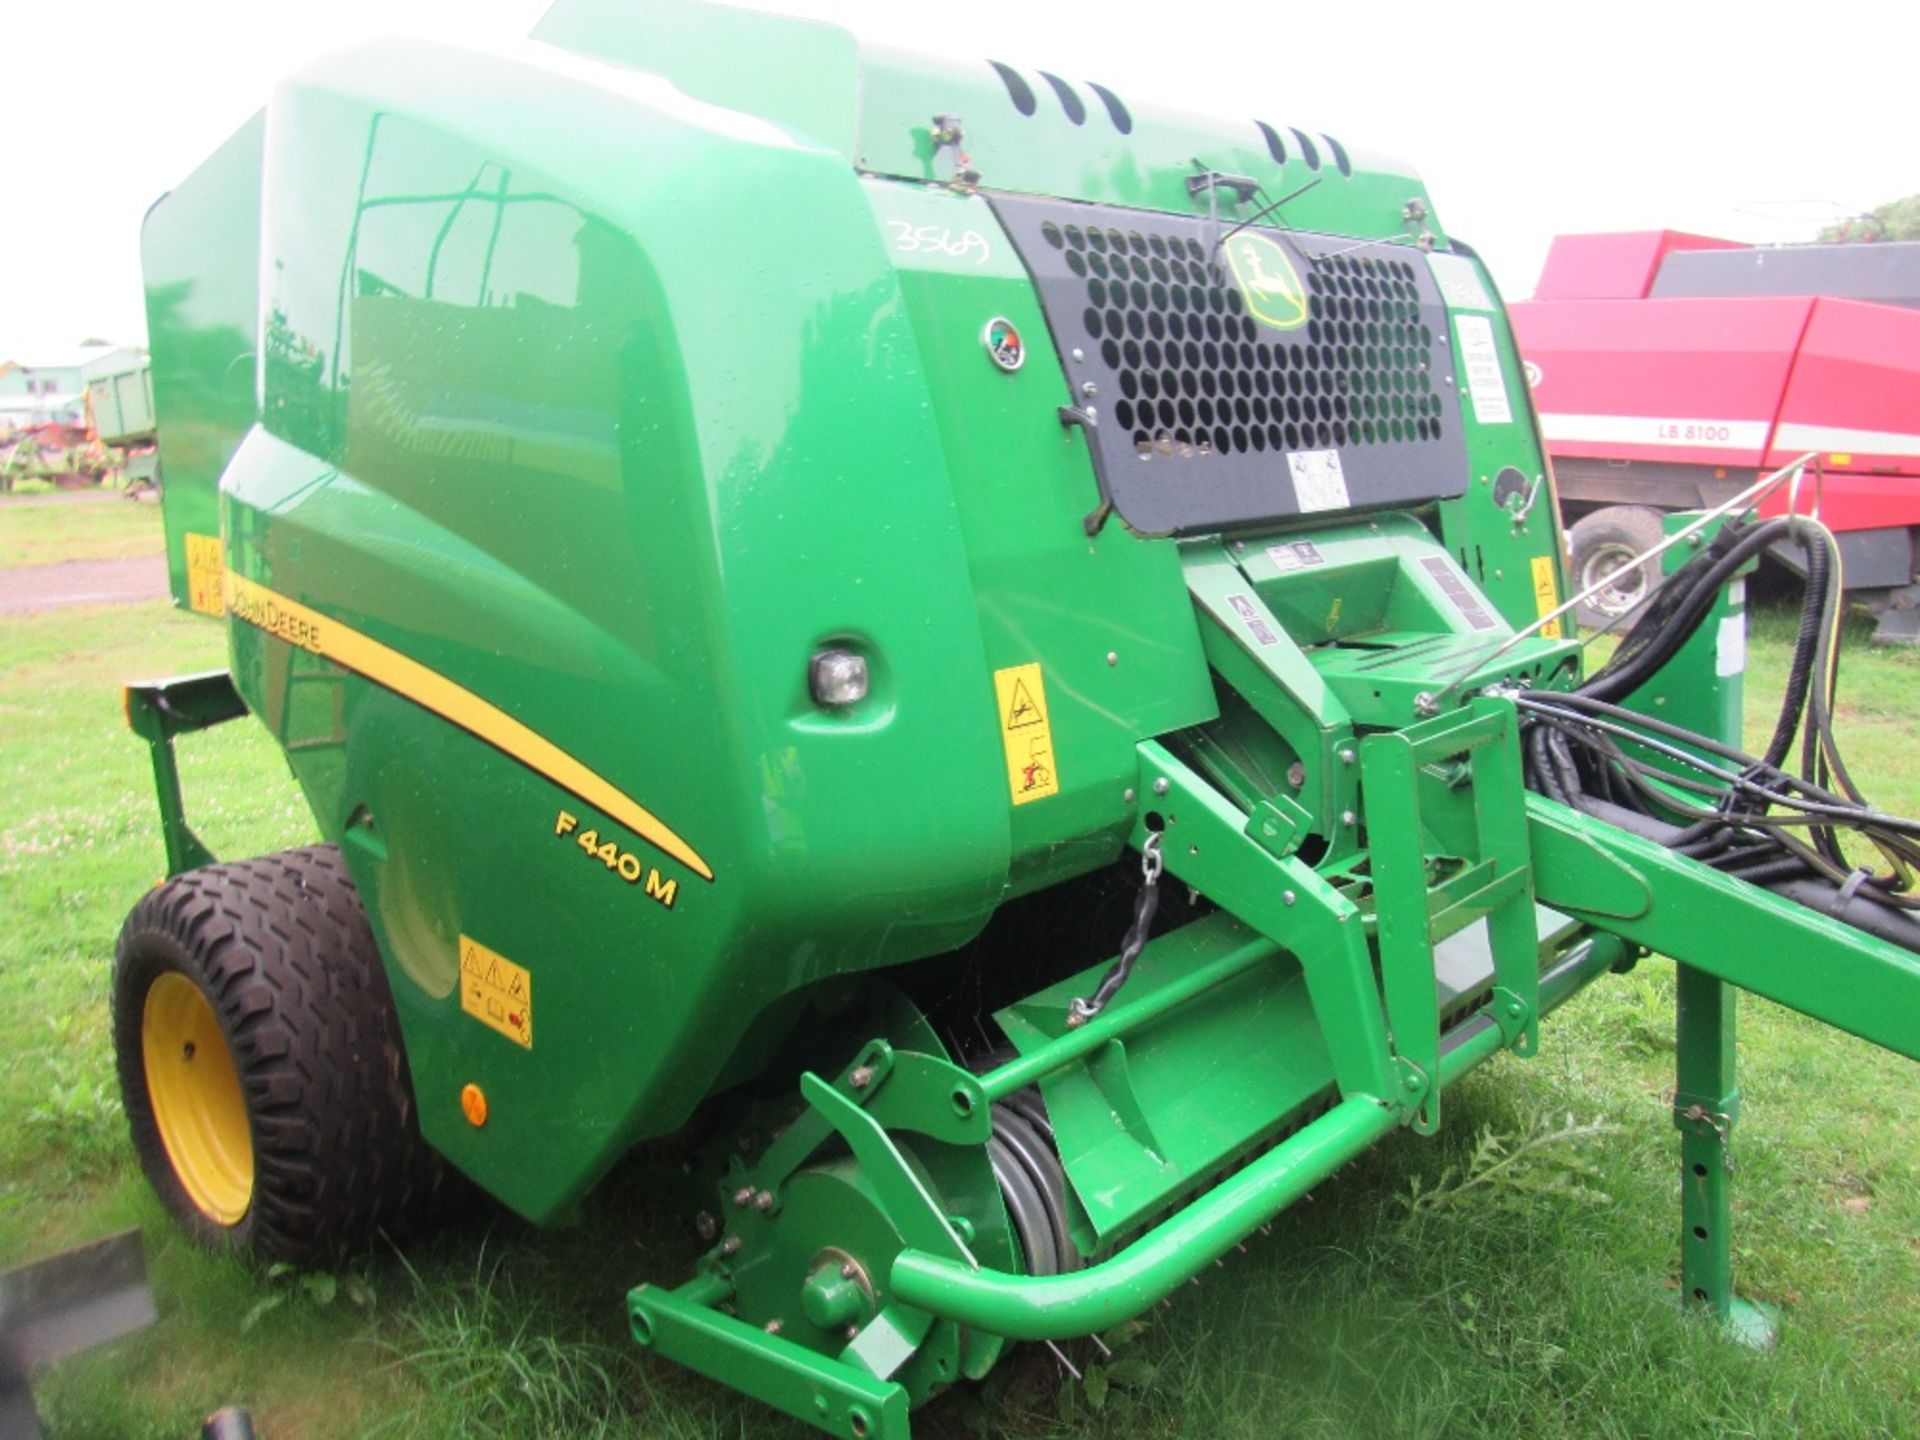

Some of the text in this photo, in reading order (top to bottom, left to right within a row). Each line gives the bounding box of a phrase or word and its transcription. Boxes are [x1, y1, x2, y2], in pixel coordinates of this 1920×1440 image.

[887, 219, 990, 265] 3569
[1658, 425, 1730, 441] LB 8100
[266, 600, 320, 649] DEERE
[555, 809, 678, 907] F 440 M
